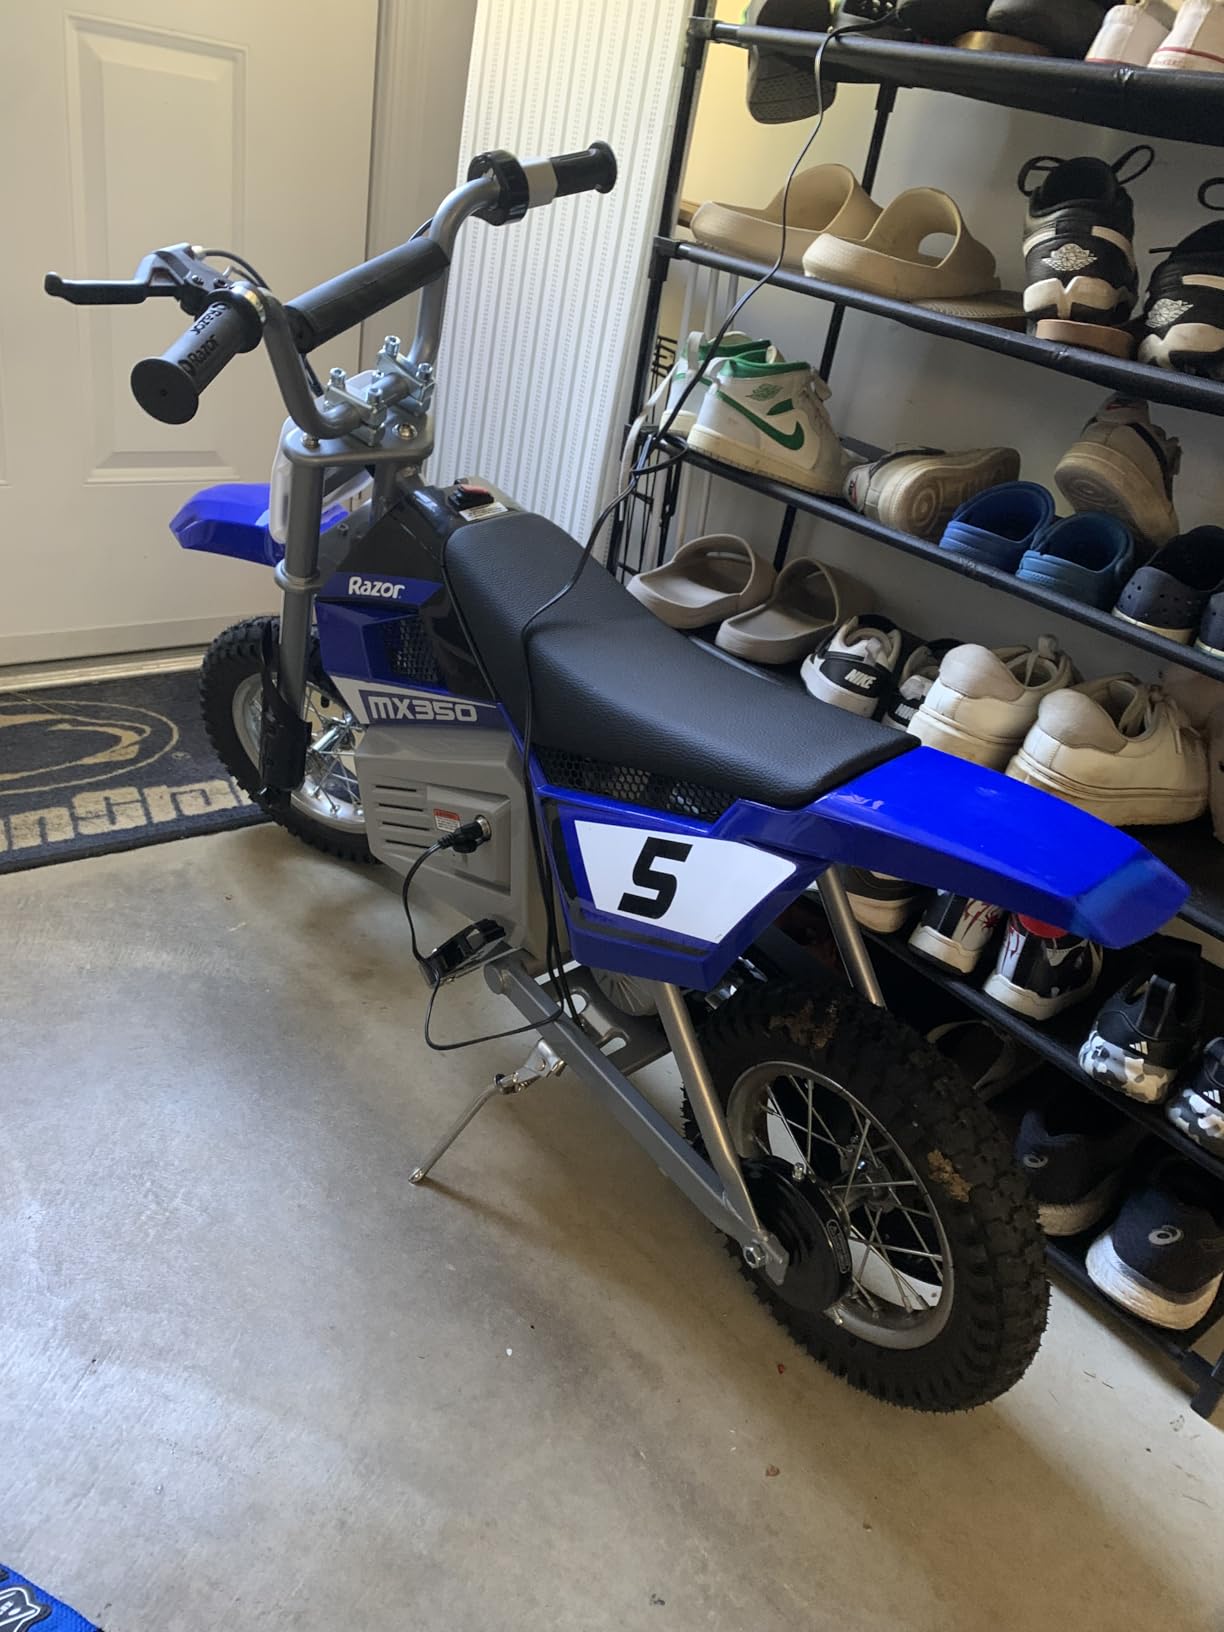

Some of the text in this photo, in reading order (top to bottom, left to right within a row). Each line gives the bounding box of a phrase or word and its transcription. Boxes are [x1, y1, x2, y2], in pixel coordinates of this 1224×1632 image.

[187, 334, 219, 366] Razor
[348, 576, 406, 599] Razor
[844, 668, 877, 690] NIKE
[367, 696, 478, 722] MX350
[617, 836, 694, 919] 5
